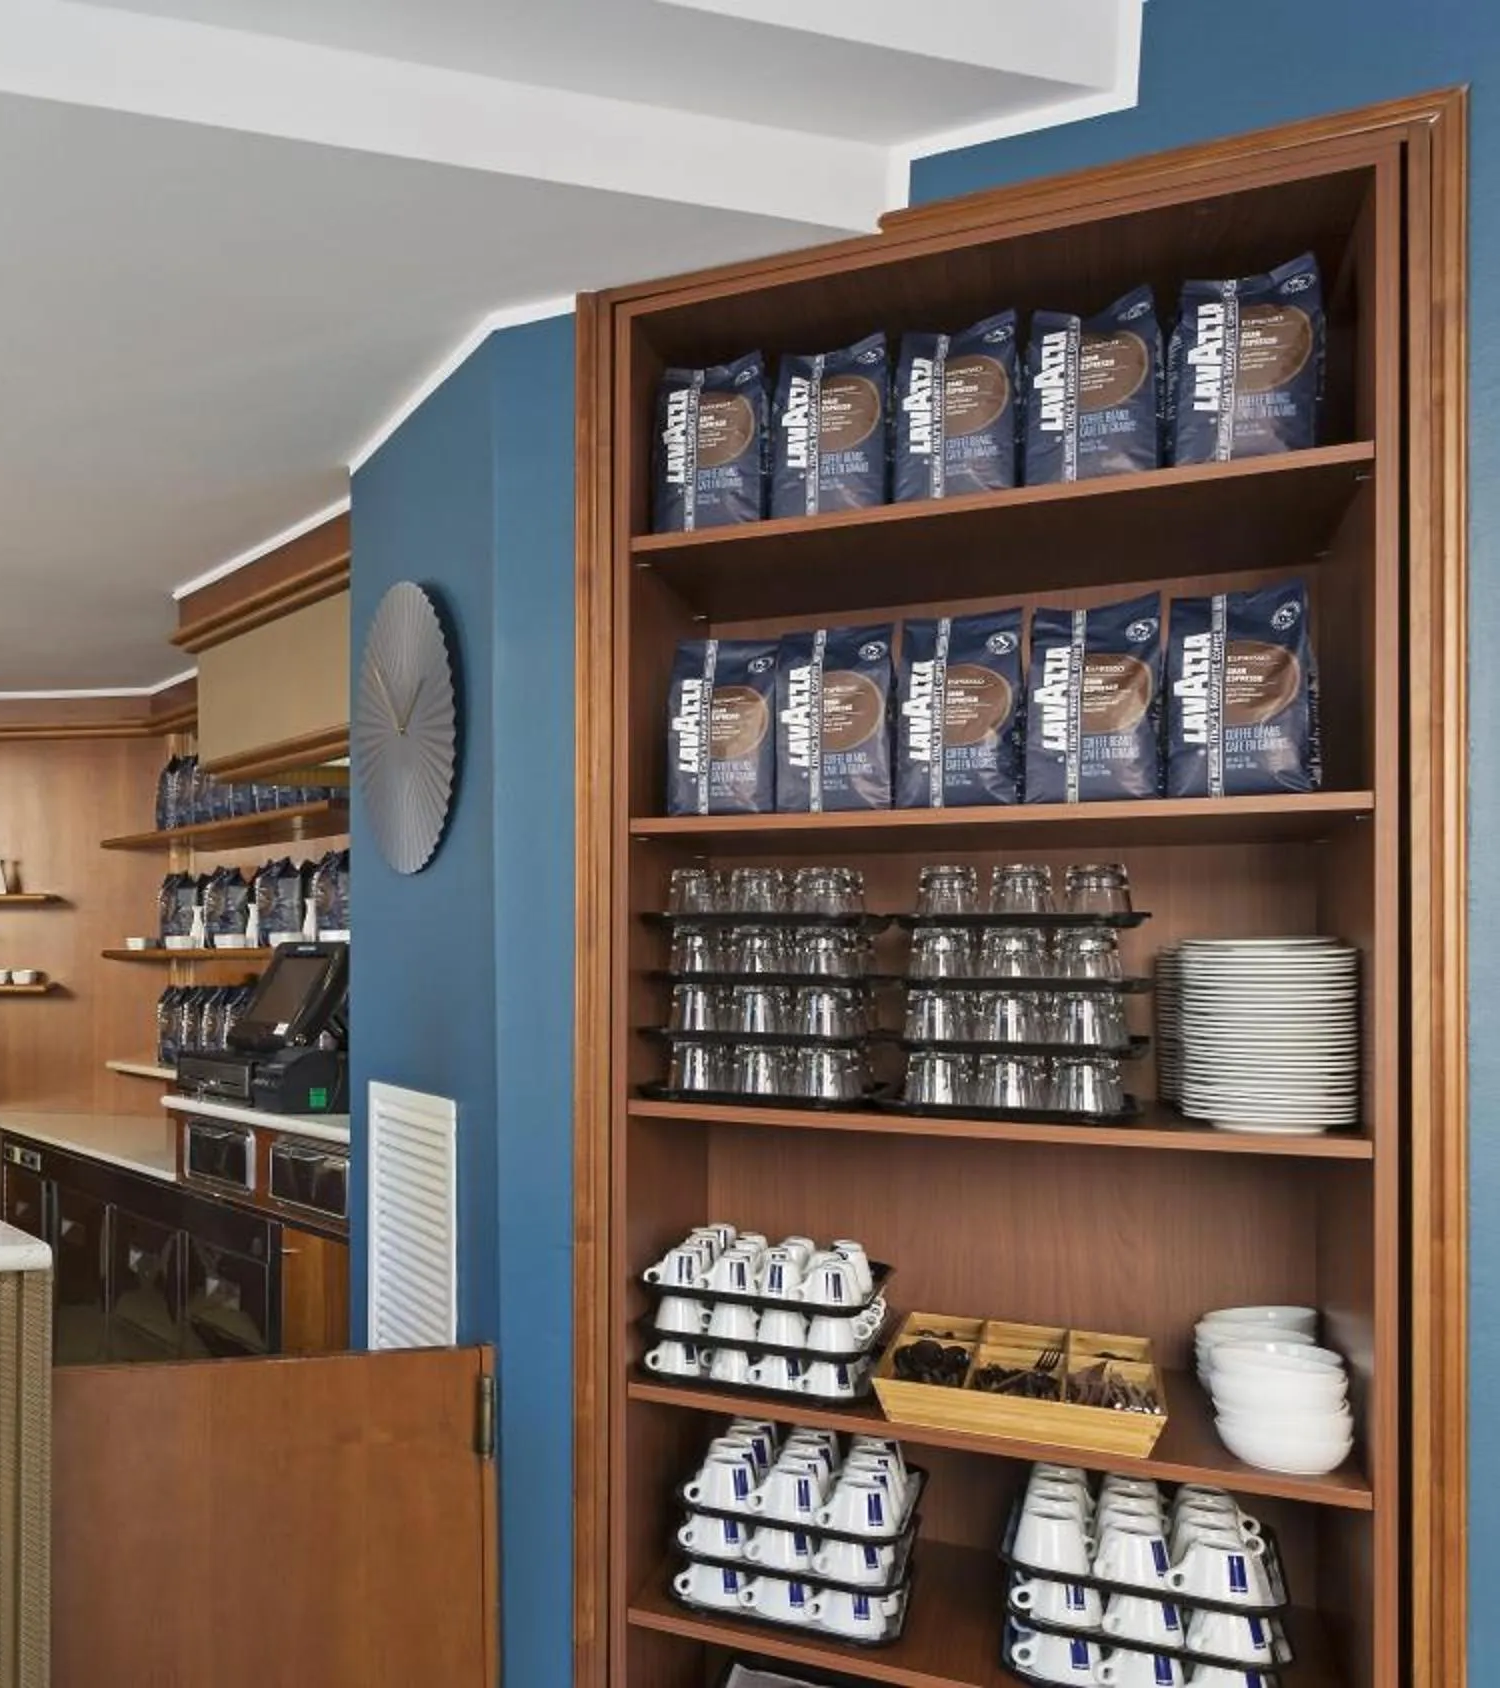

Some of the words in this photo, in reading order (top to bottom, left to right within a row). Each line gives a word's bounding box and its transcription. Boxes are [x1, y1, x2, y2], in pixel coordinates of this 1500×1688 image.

[1034, 331, 1067, 431] LAVAZZA
[1188, 303, 1224, 411] LAVAZZA
[662, 389, 688, 483] LAVAZZA
[672, 679, 703, 774] LAVAZZA
[780, 665, 811, 768] LAVAZZA
[902, 660, 934, 761] LAVAZZA
[1034, 646, 1071, 752] LAVAZZA
[1174, 632, 1211, 743] LAVAZZA
